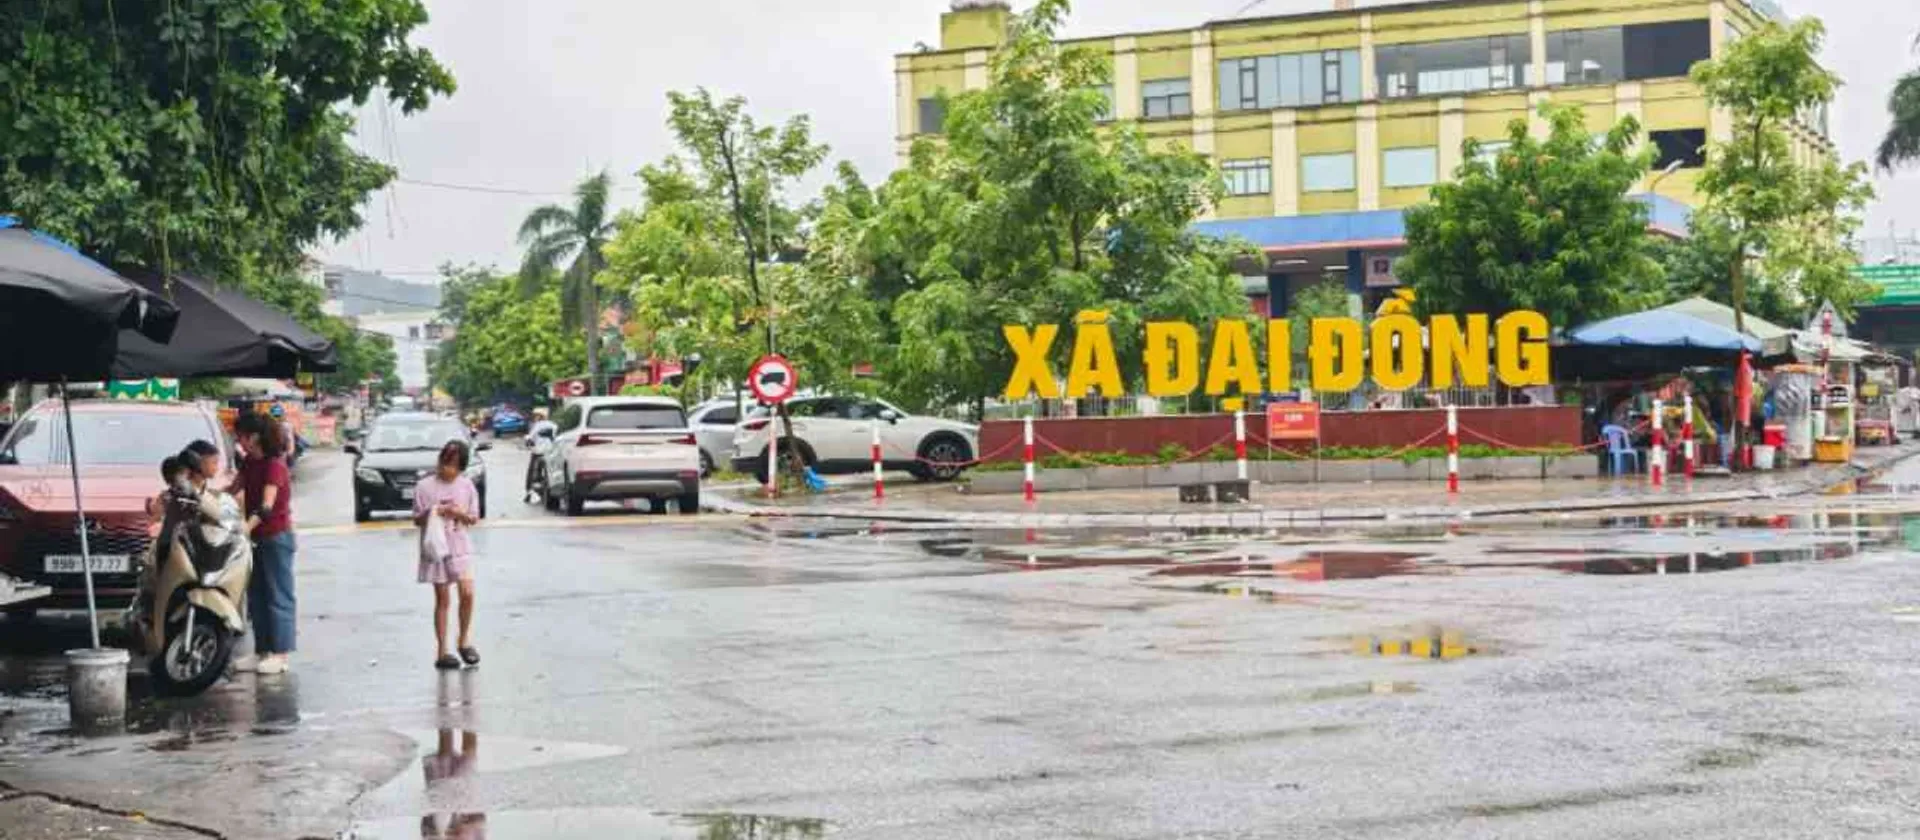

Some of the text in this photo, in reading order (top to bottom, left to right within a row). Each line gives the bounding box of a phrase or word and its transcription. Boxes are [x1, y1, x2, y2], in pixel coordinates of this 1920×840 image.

[1003, 287, 1549, 412] XÃ ĐẠI ĐỒNG
